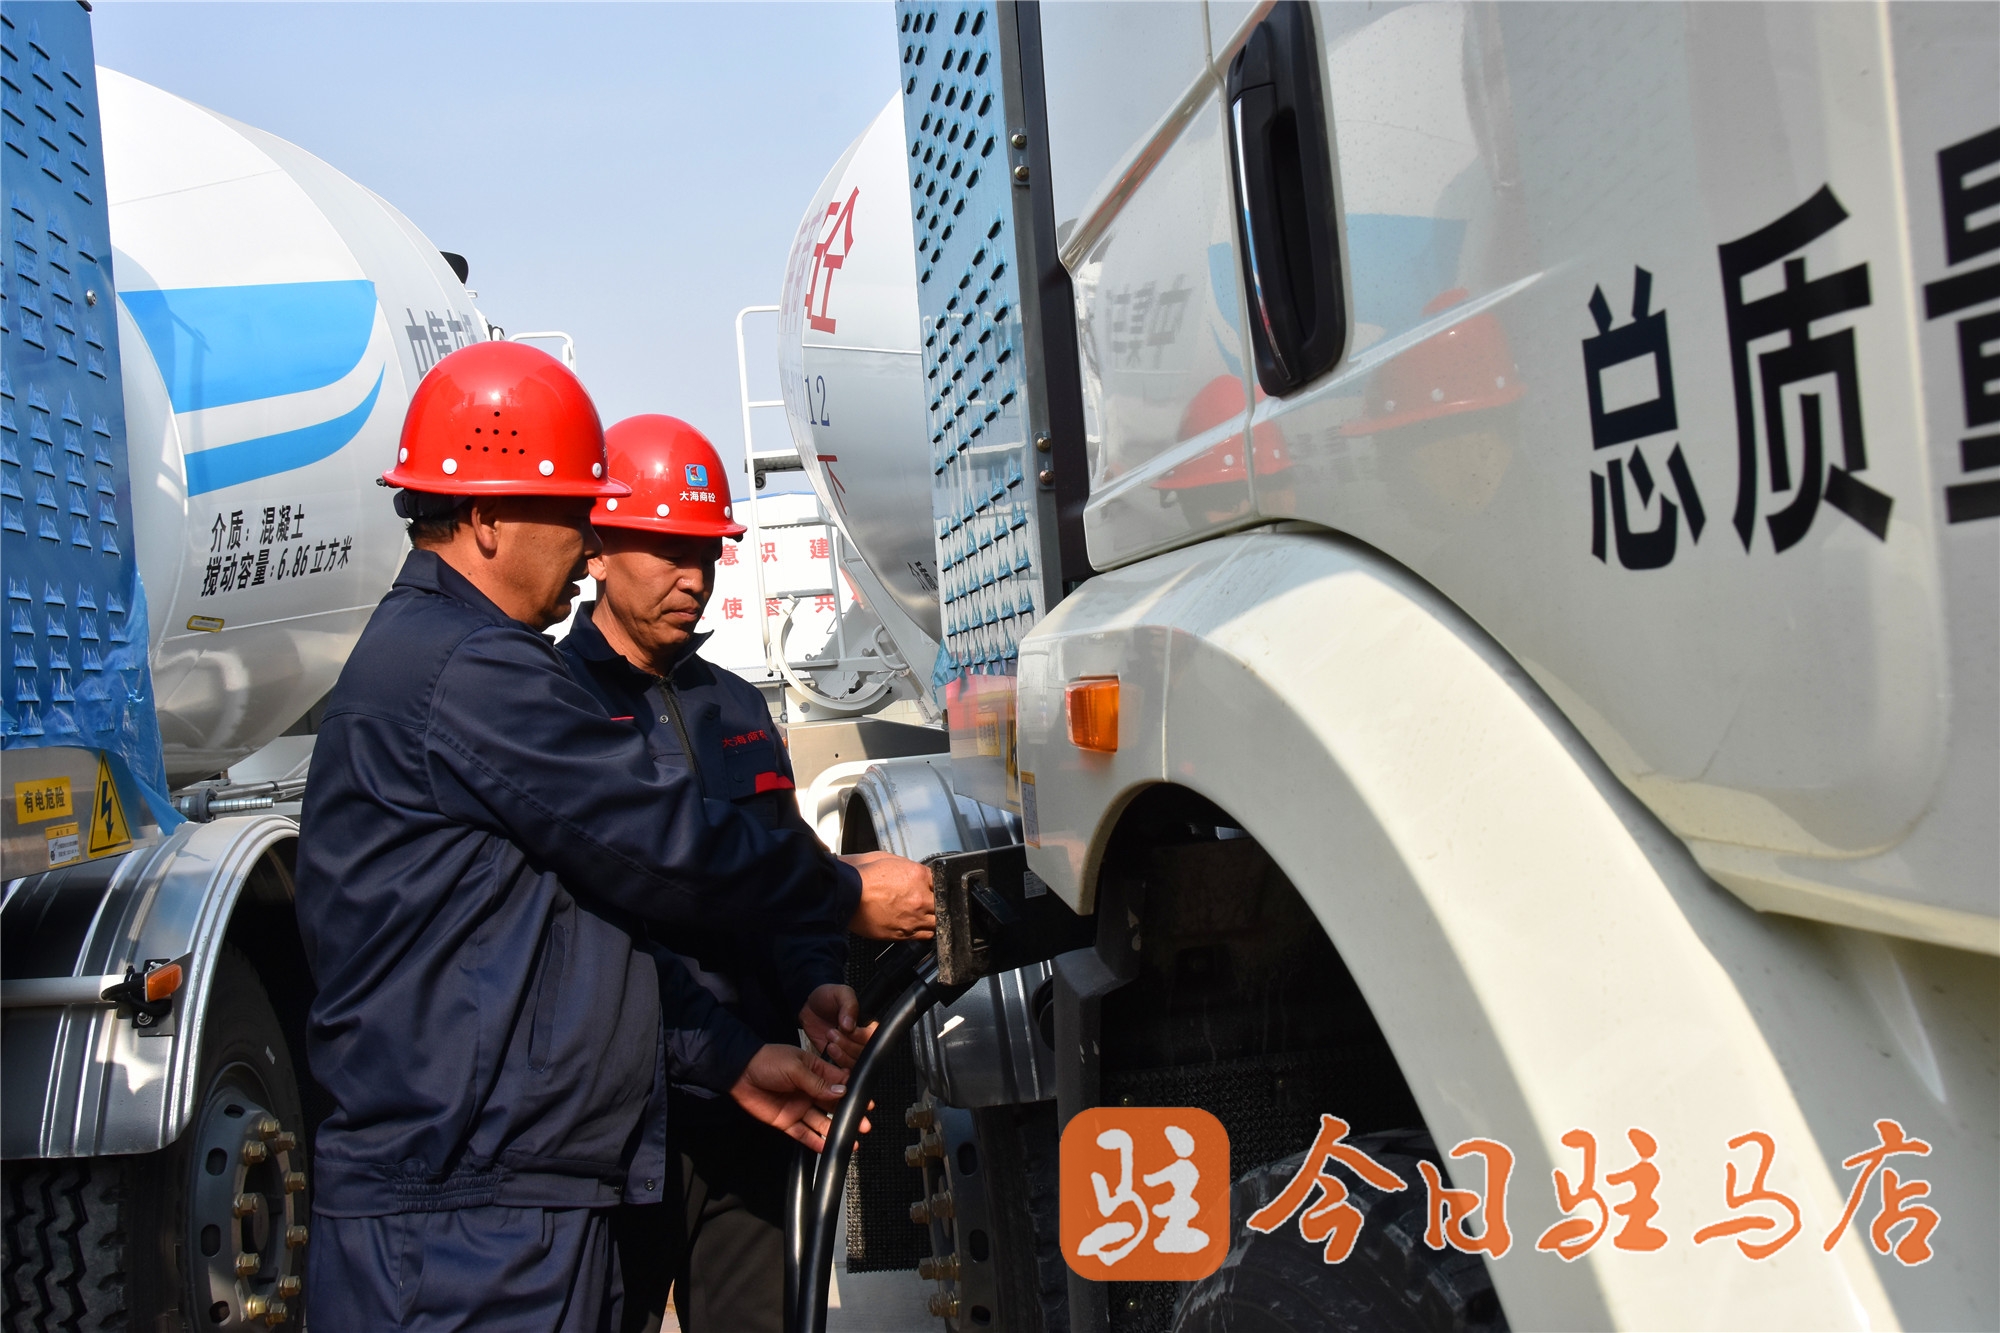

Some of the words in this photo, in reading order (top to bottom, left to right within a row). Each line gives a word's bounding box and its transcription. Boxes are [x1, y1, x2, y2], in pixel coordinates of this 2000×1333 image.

[679, 490, 716, 503] 大海商砼
[210, 503, 305, 553] 介质：混凝土
[23, 786, 66, 814] 有电危险
